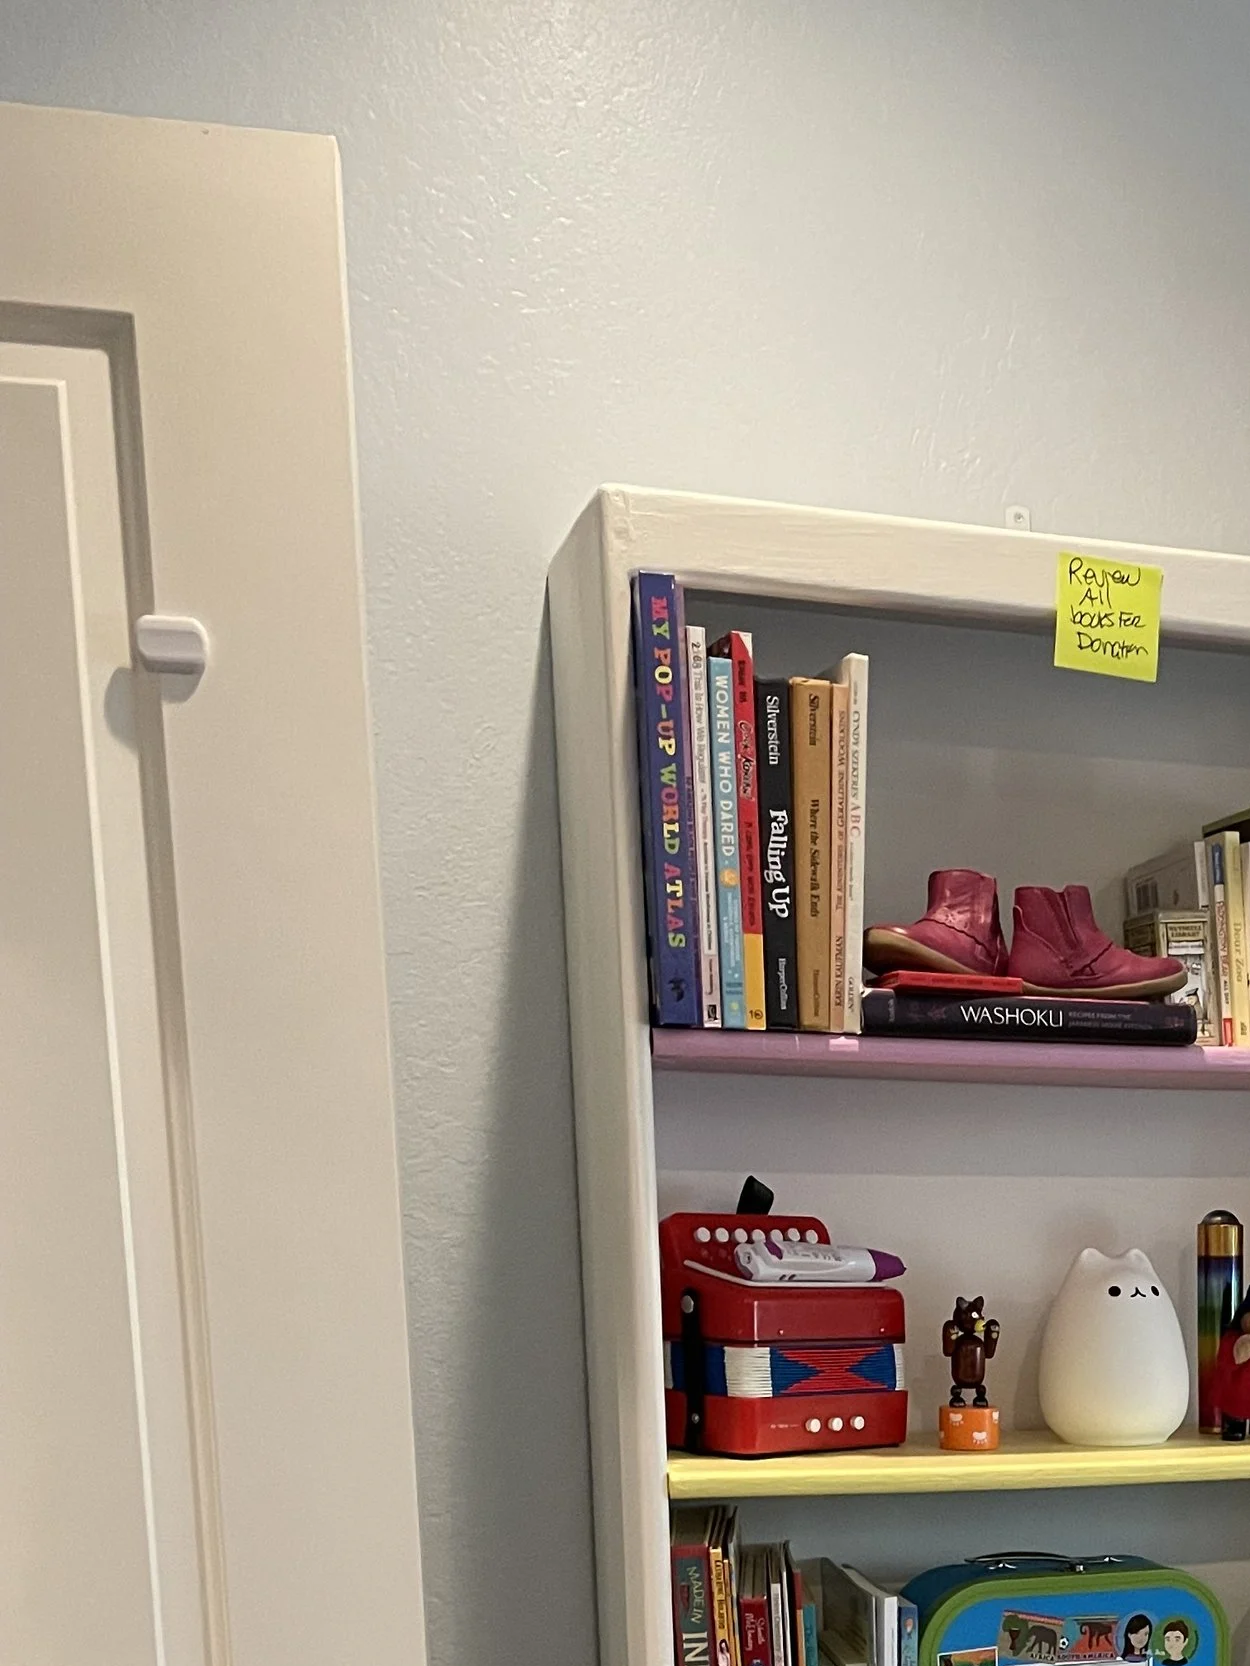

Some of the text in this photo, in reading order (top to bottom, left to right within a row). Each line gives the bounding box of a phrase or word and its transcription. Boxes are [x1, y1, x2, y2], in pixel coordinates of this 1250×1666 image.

[1079, 587, 1112, 609] All
[765, 696, 780, 765] Silverstein
[852, 710, 860, 747] CYNDY
[651, 596, 686, 948] MY POP-UP WORLD ATLAS
[715, 675, 735, 856] WOMEN WHO DARED
[809, 693, 820, 917] Silverstein Where the Sidewalk Ends
[763, 809, 790, 885] Falling
[768, 886, 790, 918] Up
[1233, 923, 1243, 983] Dear Zoo
[960, 1005, 1063, 1028] WASHOKU
[688, 1565, 705, 1604] MADE
[690, 1607, 704, 1624] IN
